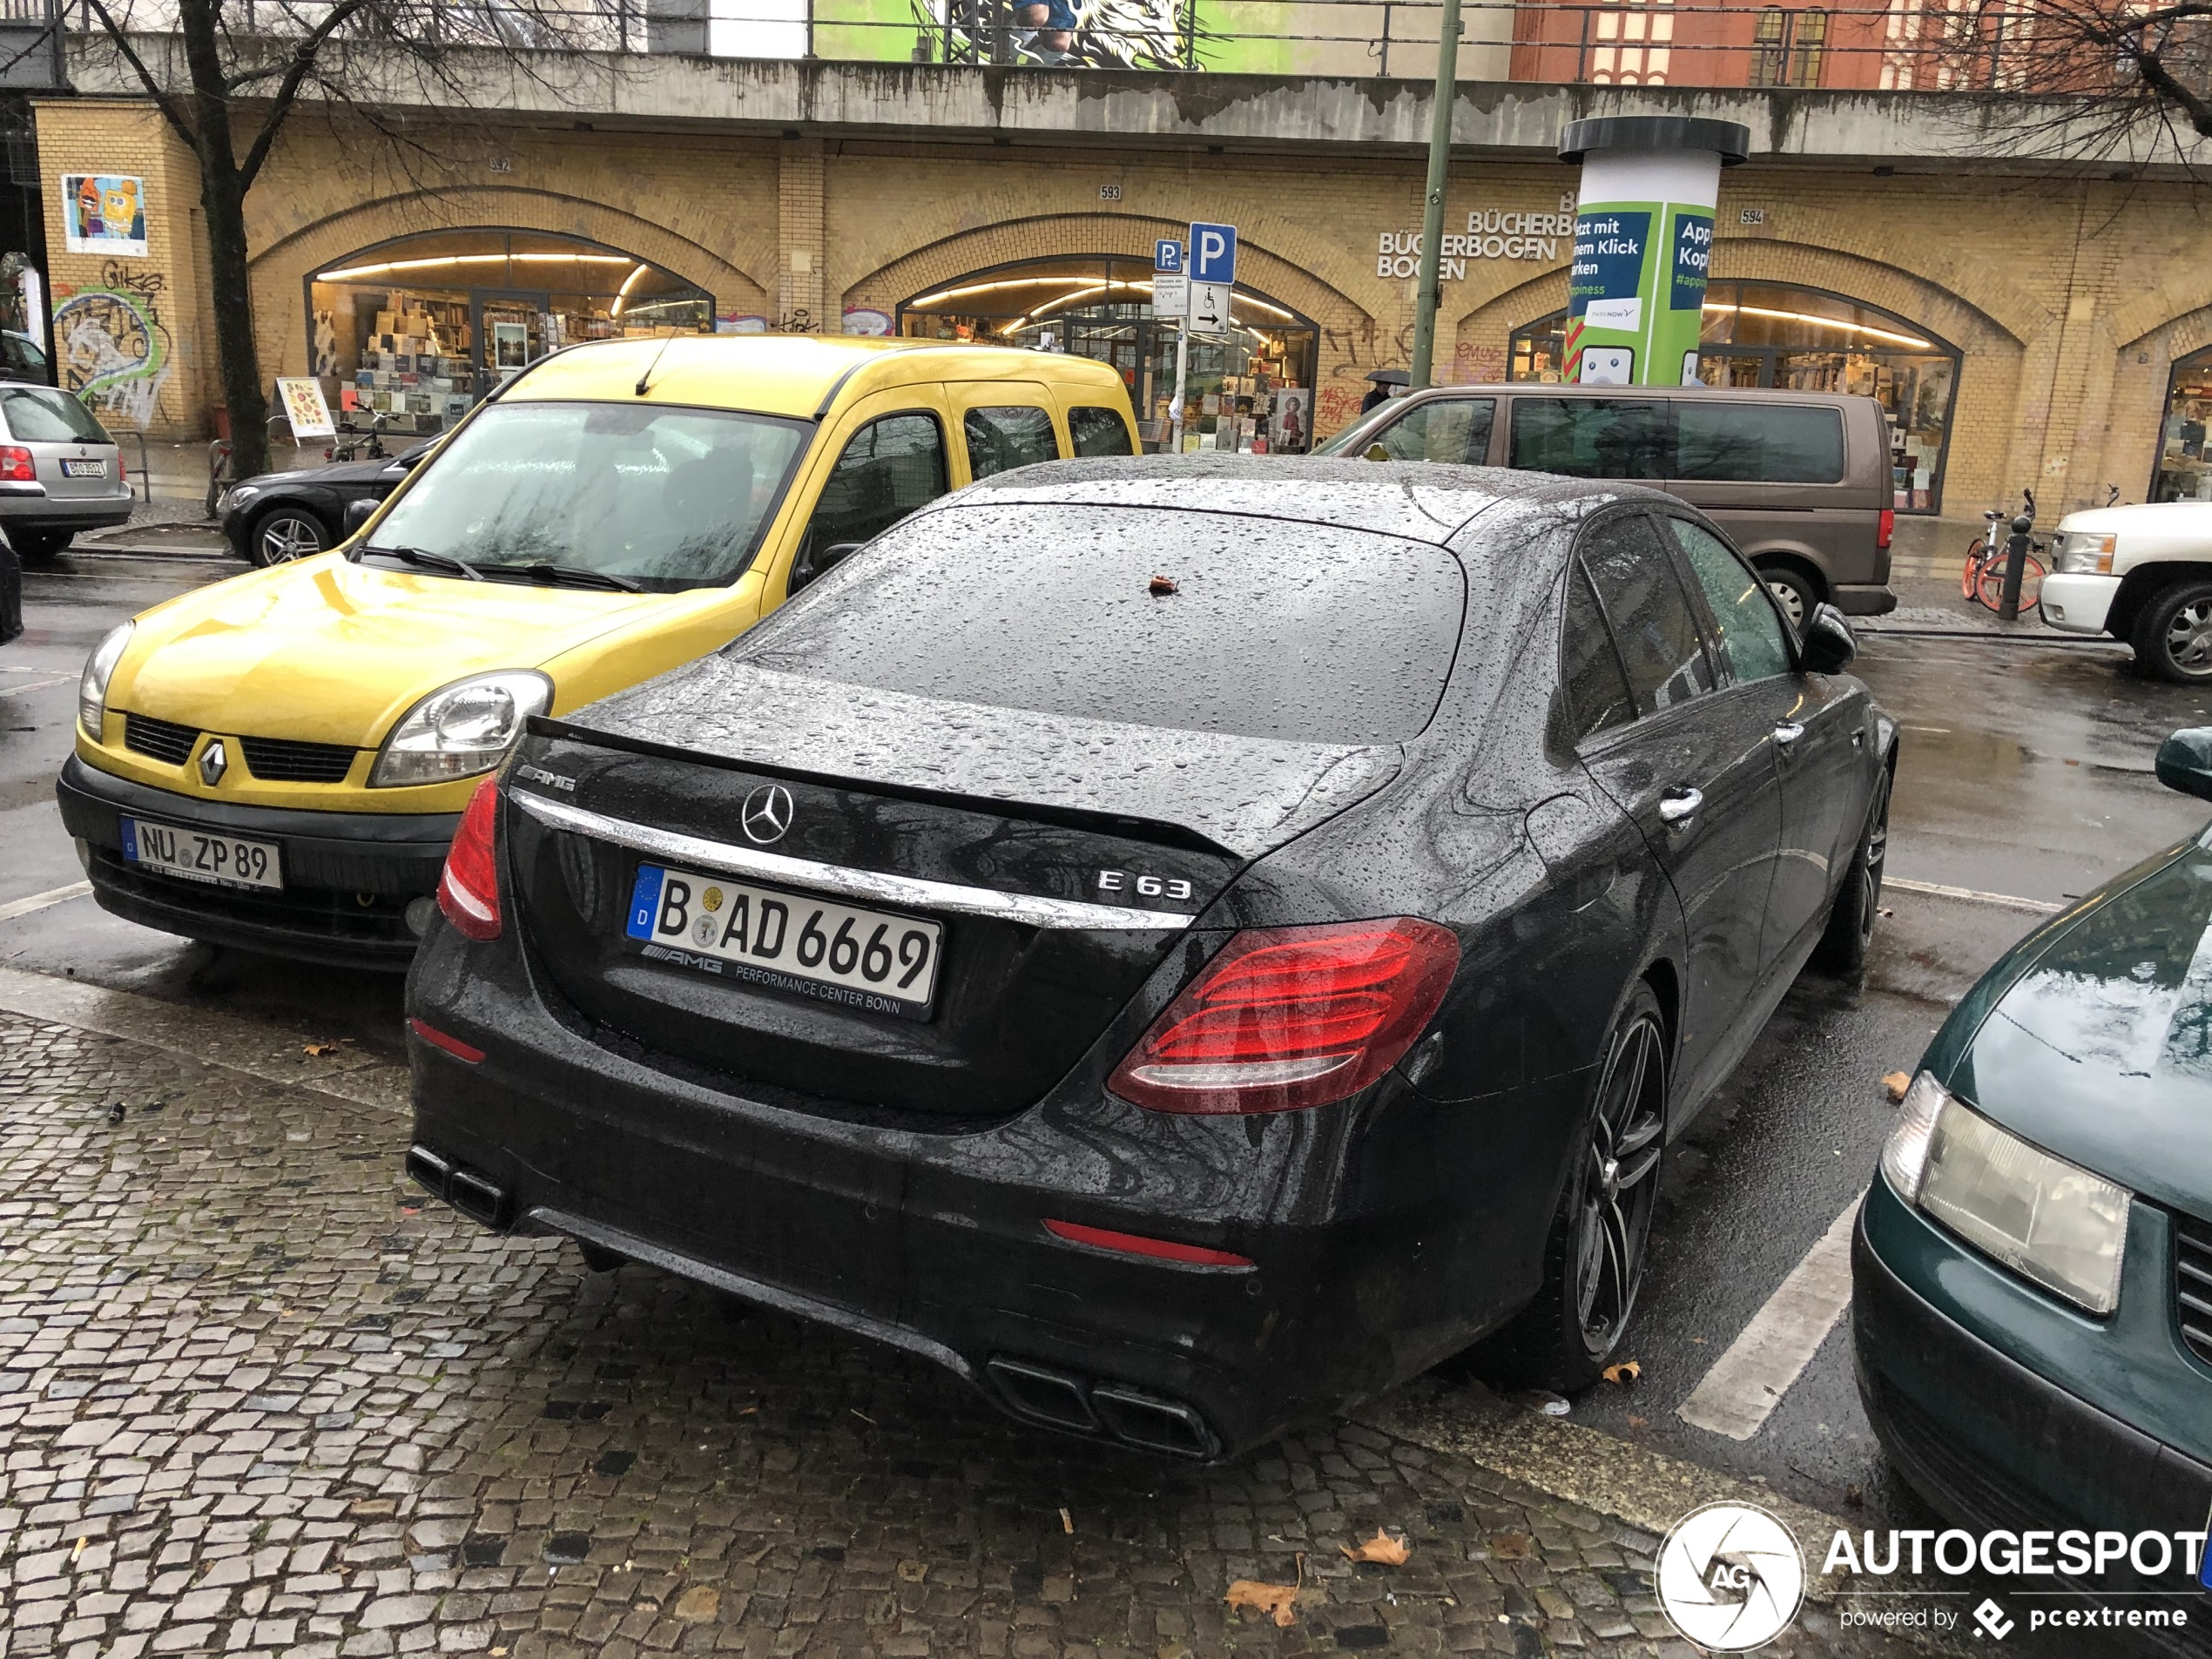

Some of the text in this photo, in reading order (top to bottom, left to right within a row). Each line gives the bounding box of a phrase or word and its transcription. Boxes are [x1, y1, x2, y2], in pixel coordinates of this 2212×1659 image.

[1102, 185, 1120, 199] 593
[1559, 191, 1580, 212] B
[1467, 208, 1578, 236] BÜCHERB
[1594, 218, 1620, 234] mit
[1742, 210, 1762, 223] 594
[1161, 244, 1176, 266] P
[1200, 231, 1225, 274] P
[1379, 229, 1556, 260] BÜCERBOGEN
[1597, 238, 1639, 255] Klick
[1377, 255, 1467, 280] BOEN
[531, 769, 577, 792] AMG
[127, 842, 133, 853] D
[141, 826, 268, 880] NU ZP 89
[1098, 870, 1191, 900] E 63
[637, 908, 648, 926] D
[658, 878, 931, 989] B AD 6669
[664, 950, 900, 1015] AMG PERFORMANCE CENTER BONN
